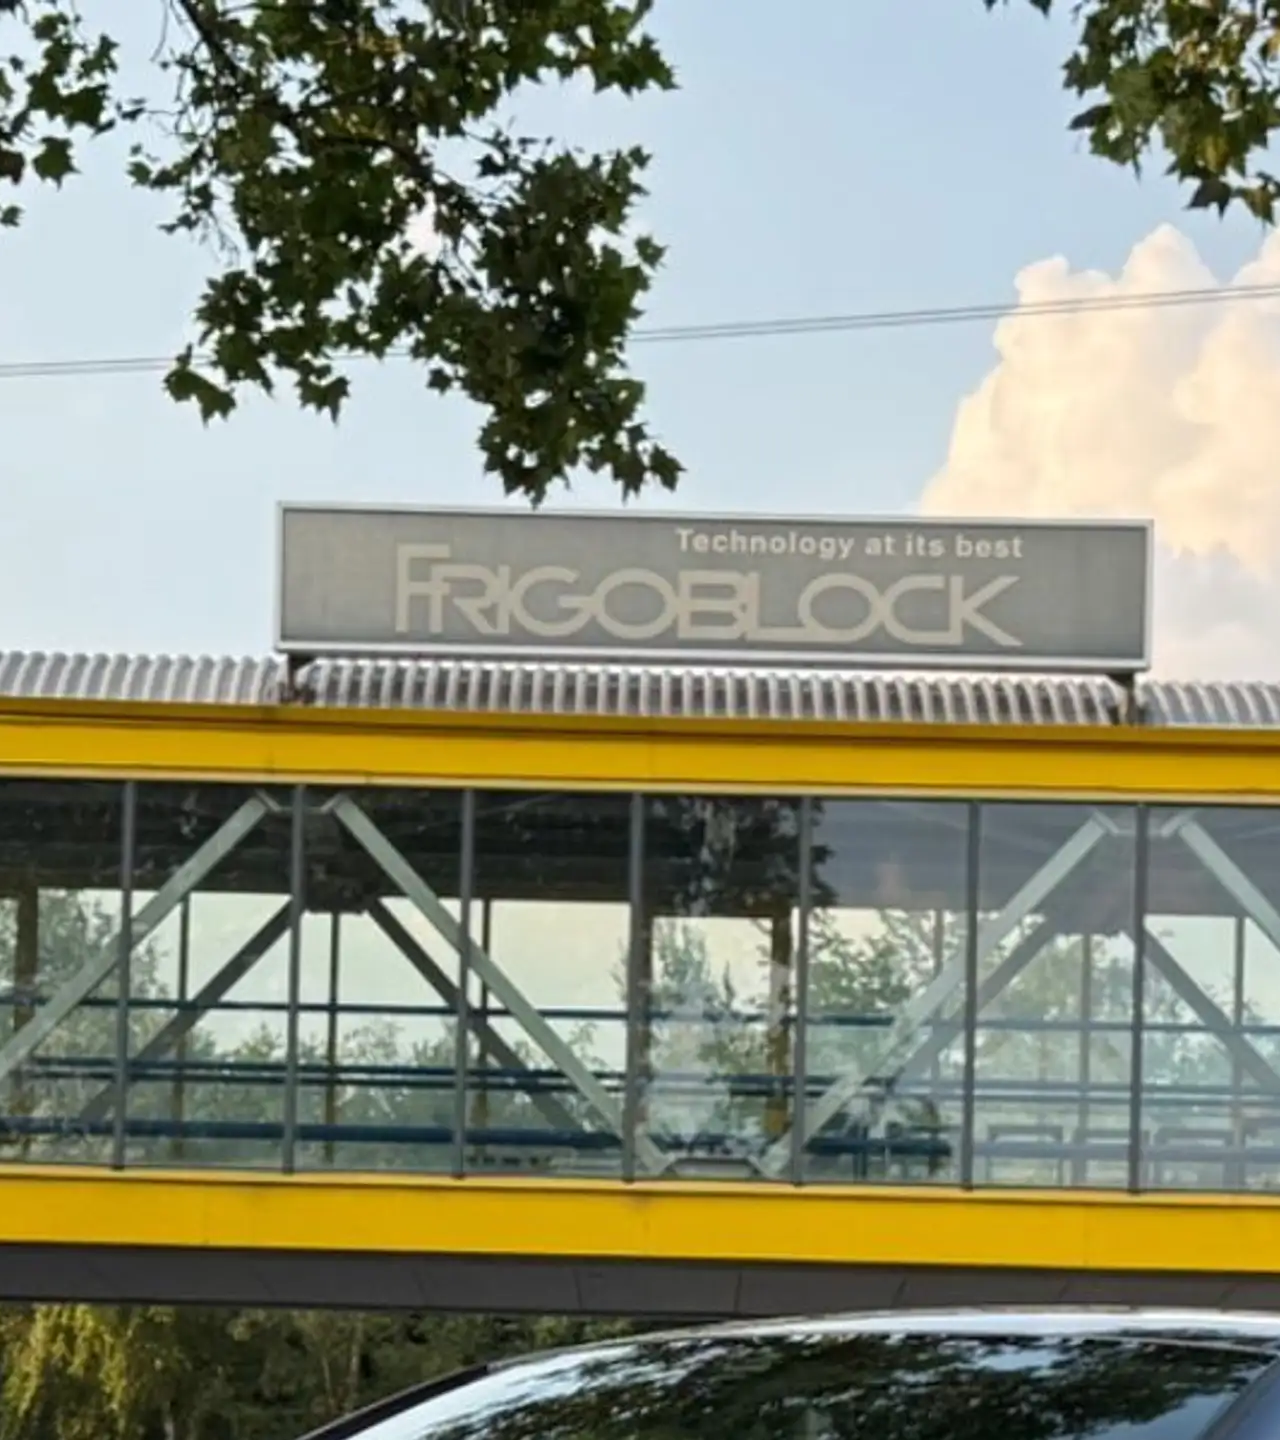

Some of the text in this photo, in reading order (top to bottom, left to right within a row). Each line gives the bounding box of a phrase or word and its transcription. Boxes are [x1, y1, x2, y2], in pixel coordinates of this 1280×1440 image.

[676, 528, 1024, 561] Technology at its best
[395, 543, 1024, 647] FRIGOBLOCK
